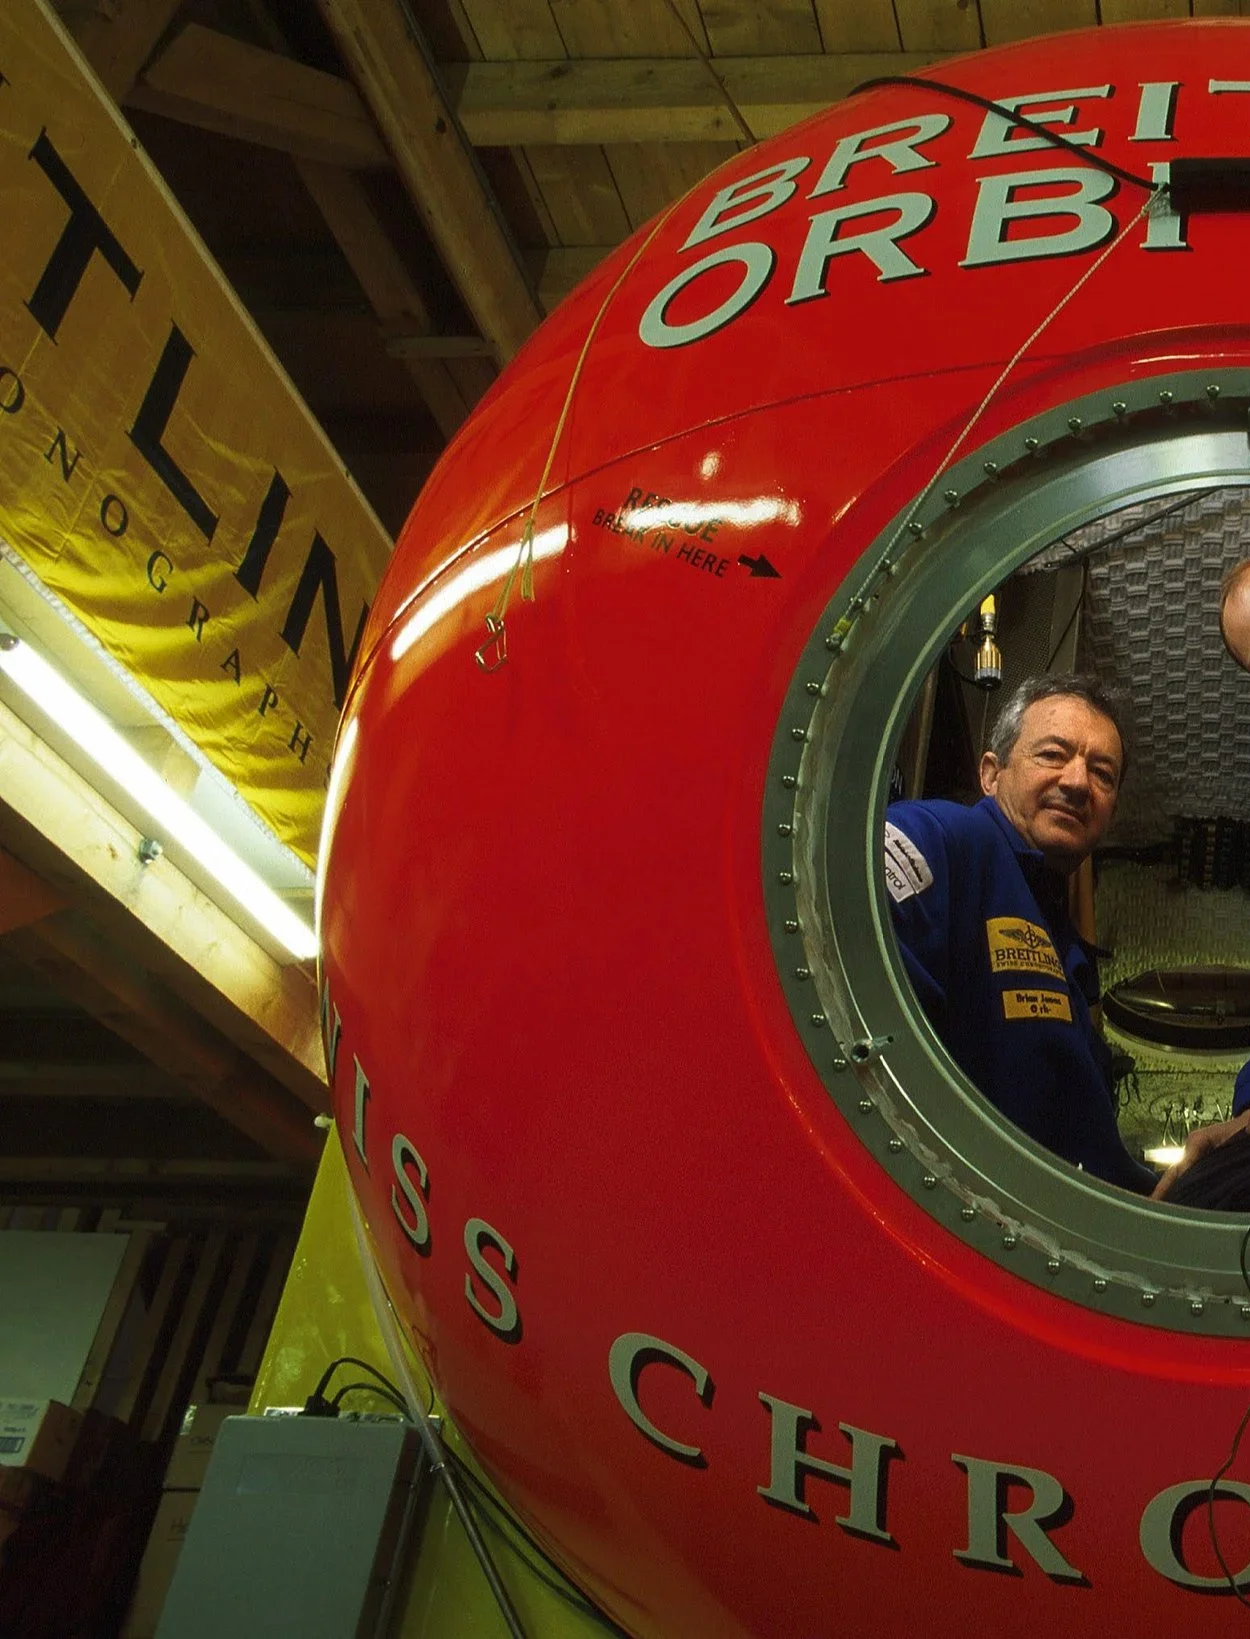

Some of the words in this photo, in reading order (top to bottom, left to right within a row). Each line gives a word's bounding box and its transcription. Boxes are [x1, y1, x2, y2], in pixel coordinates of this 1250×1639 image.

[0, 76, 372, 712] TLIN
[0, 364, 332, 780] ONOGRAPH
[651, 531, 674, 555] IN
[676, 542, 730, 579] HERE
[995, 947, 1061, 969] BREITLIN
